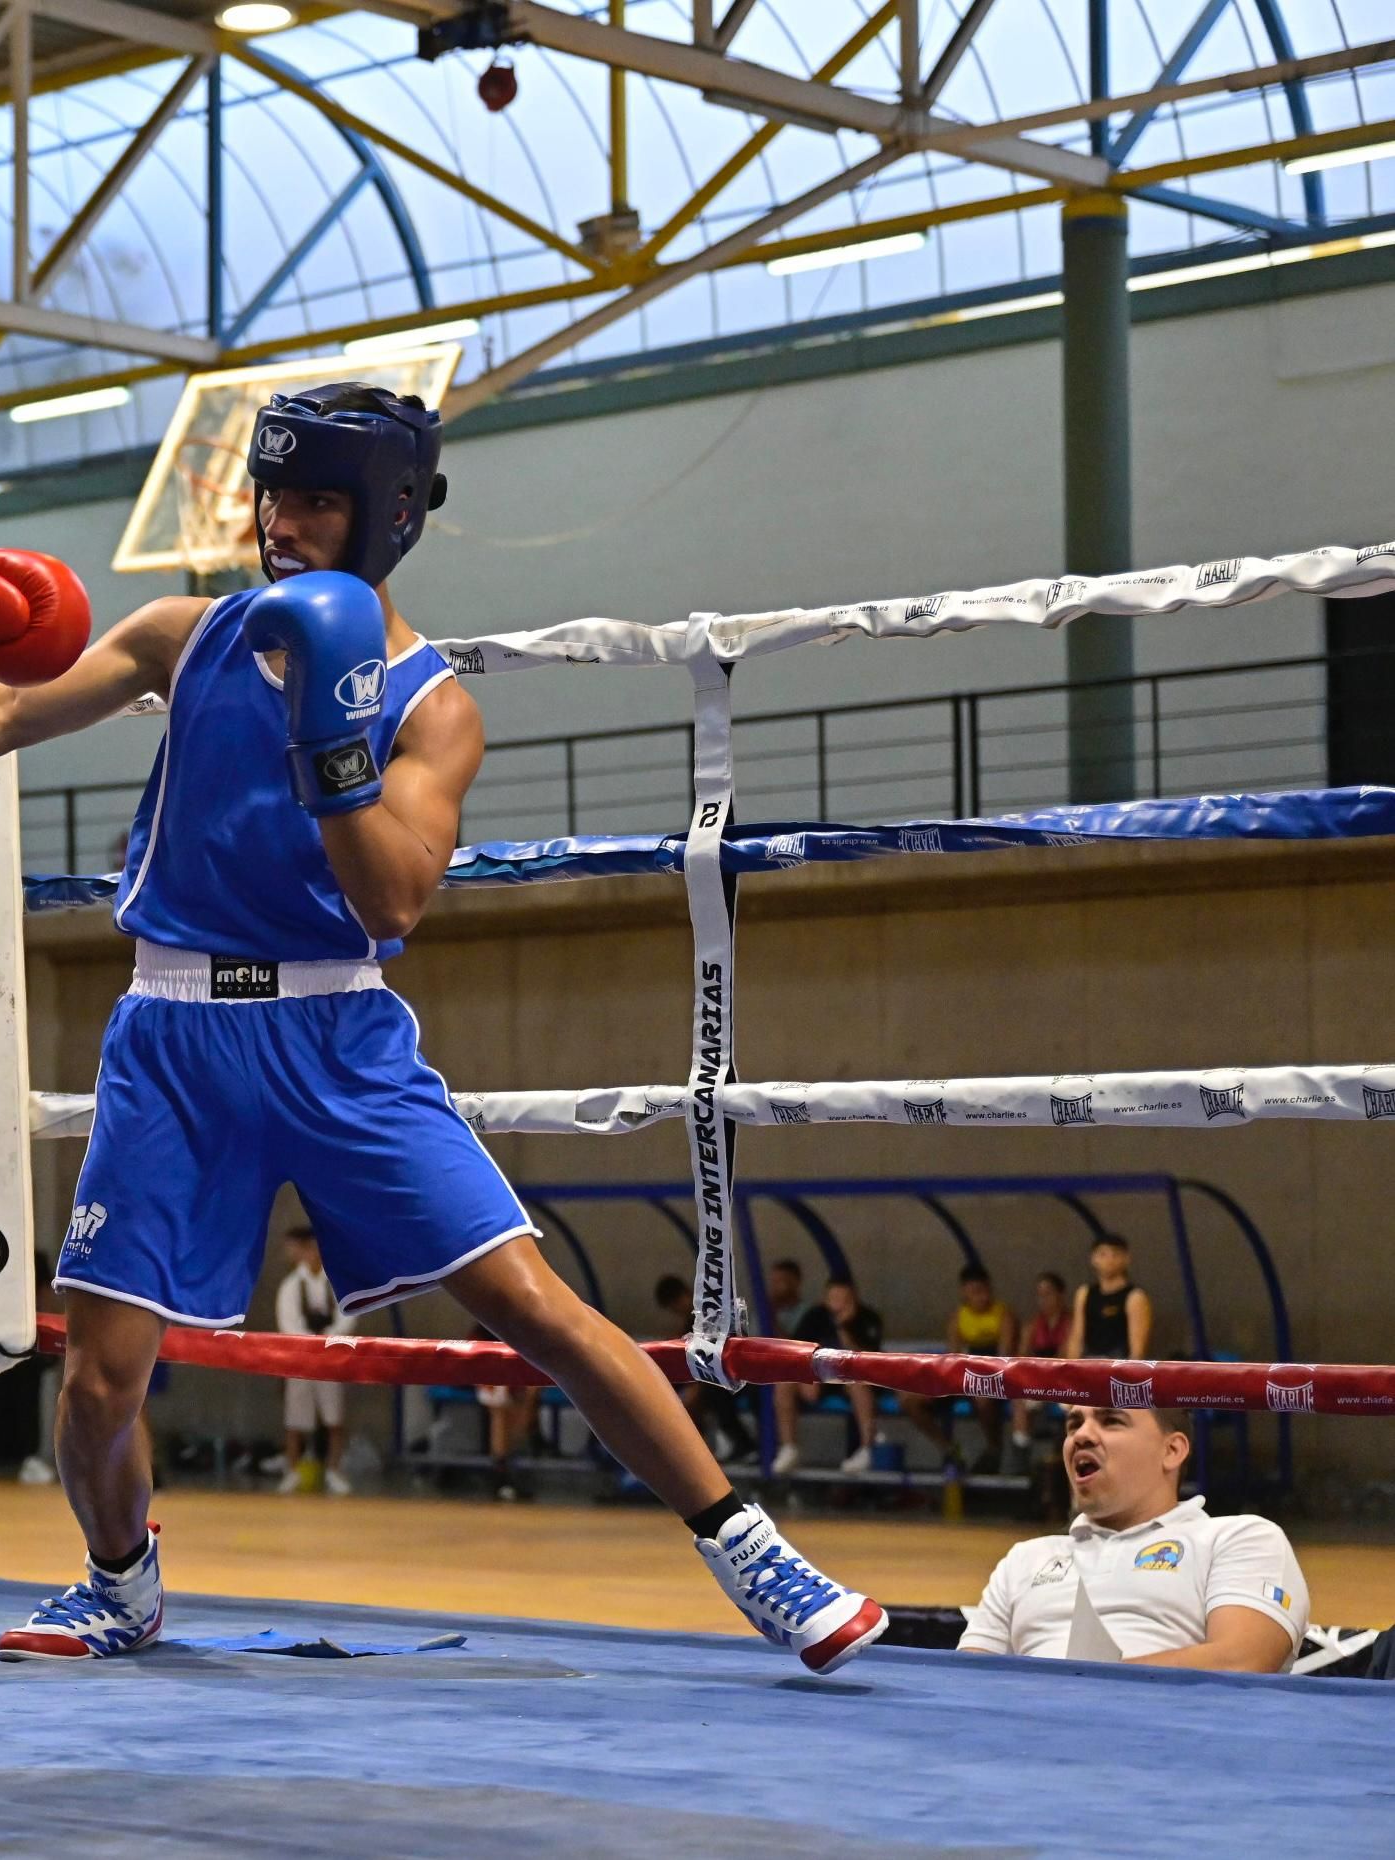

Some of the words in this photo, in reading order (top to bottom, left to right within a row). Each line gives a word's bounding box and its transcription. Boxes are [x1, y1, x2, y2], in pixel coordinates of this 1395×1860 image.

[346, 704, 380, 720] WINNER
[899, 827, 945, 855] CHARLIE
[693, 961, 723, 1221] INTERCANARIAS
[1050, 1093, 1096, 1127] CHARLIE
[1113, 1102, 1183, 1113] www.charlie.es
[1199, 1084, 1246, 1120] CHARLIE
[1264, 1095, 1336, 1106] www.charlie.es
[965, 1111, 1028, 1121] www.charlie.es
[963, 1369, 1007, 1399] CHARLIE
[1022, 1386, 1091, 1398] www.charlie.es
[1110, 1377, 1155, 1409] CHARLIE
[1176, 1393, 1245, 1404] www.charlie.es
[1266, 1381, 1315, 1414] CHARLIE
